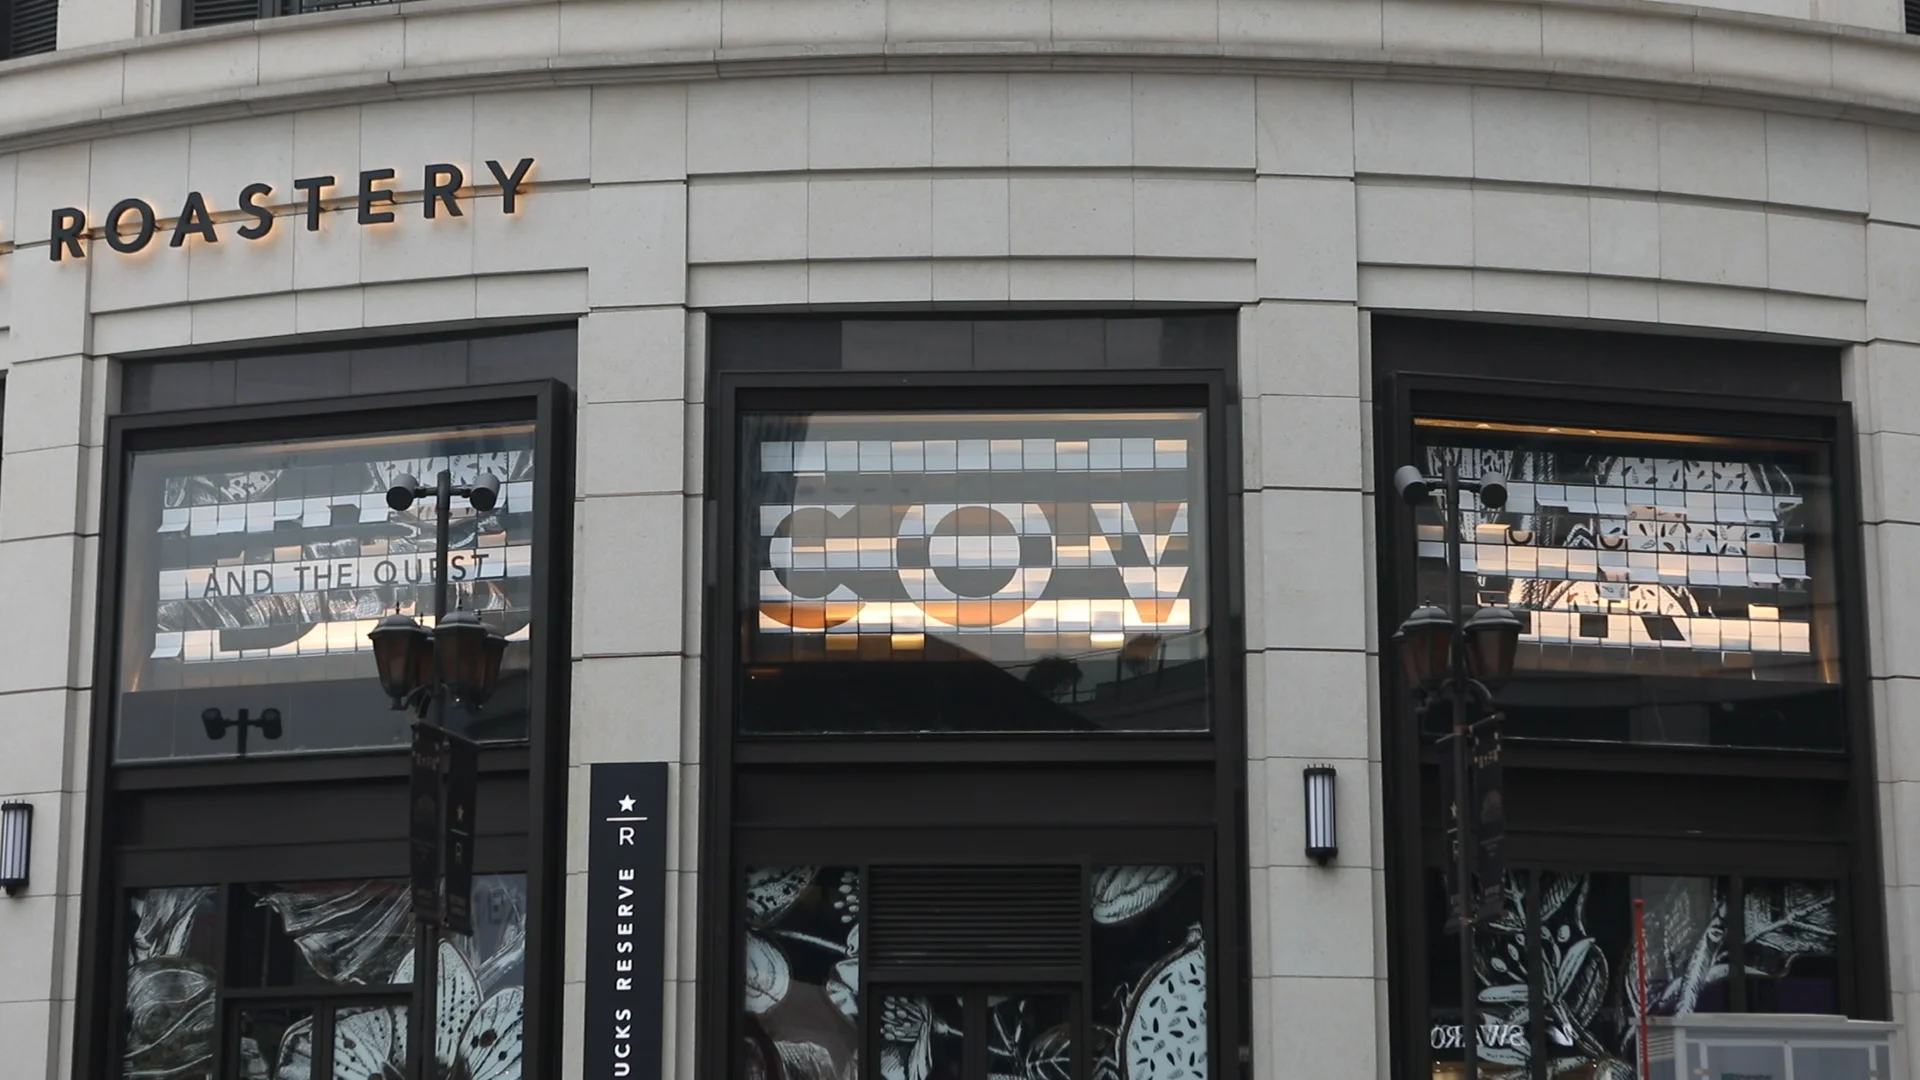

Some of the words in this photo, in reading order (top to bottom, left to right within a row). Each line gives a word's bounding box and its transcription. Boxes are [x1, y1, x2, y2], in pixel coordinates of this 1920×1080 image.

[50, 157, 535, 261] ROASTERY
[204, 566, 273, 597] AND
[294, 562, 354, 592] THE
[618, 826, 635, 845] R
[616, 868, 635, 990] RESERVE
